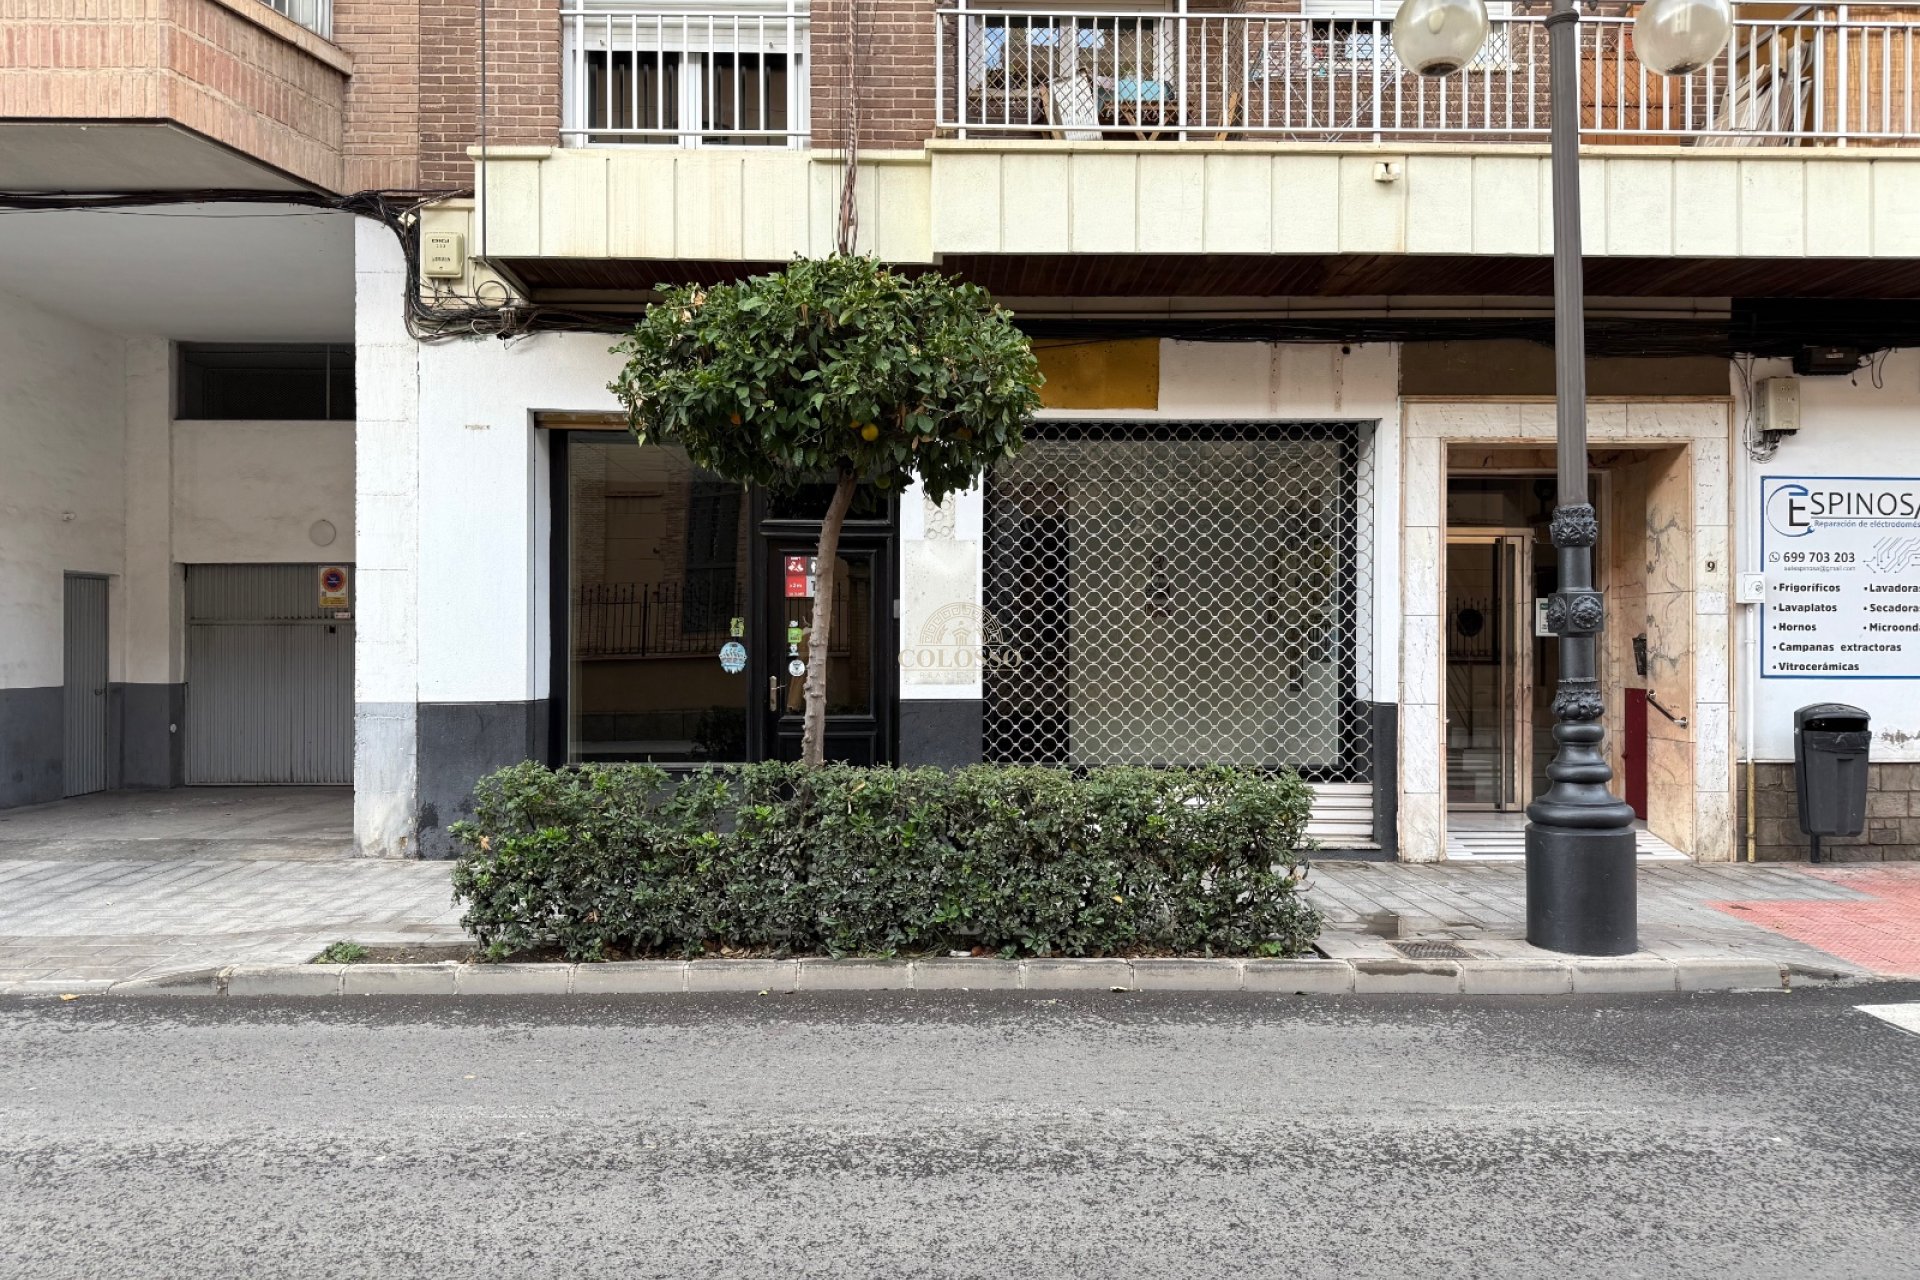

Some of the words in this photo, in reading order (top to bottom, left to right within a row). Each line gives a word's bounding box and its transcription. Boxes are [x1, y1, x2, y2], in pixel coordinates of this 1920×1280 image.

[1788, 488, 1920, 527] ESPINOS
[1814, 519, 1857, 529] Reparación
[1859, 520, 1868, 528] de
[1783, 551, 1805, 563] 699
[1809, 551, 1830, 563] 703
[1834, 551, 1856, 563] 203
[1707, 561, 1715, 572] 9
[1779, 583, 1841, 593] Frigoríficos
[1778, 602, 1838, 613] Lavaplatos
[1870, 603, 1920, 613] Secadora
[1778, 622, 1817, 632] Hornos
[1779, 642, 1835, 653] Campanas
[1840, 642, 1902, 652] extractoras
[1778, 661, 1860, 671] Vitrocerámicas
